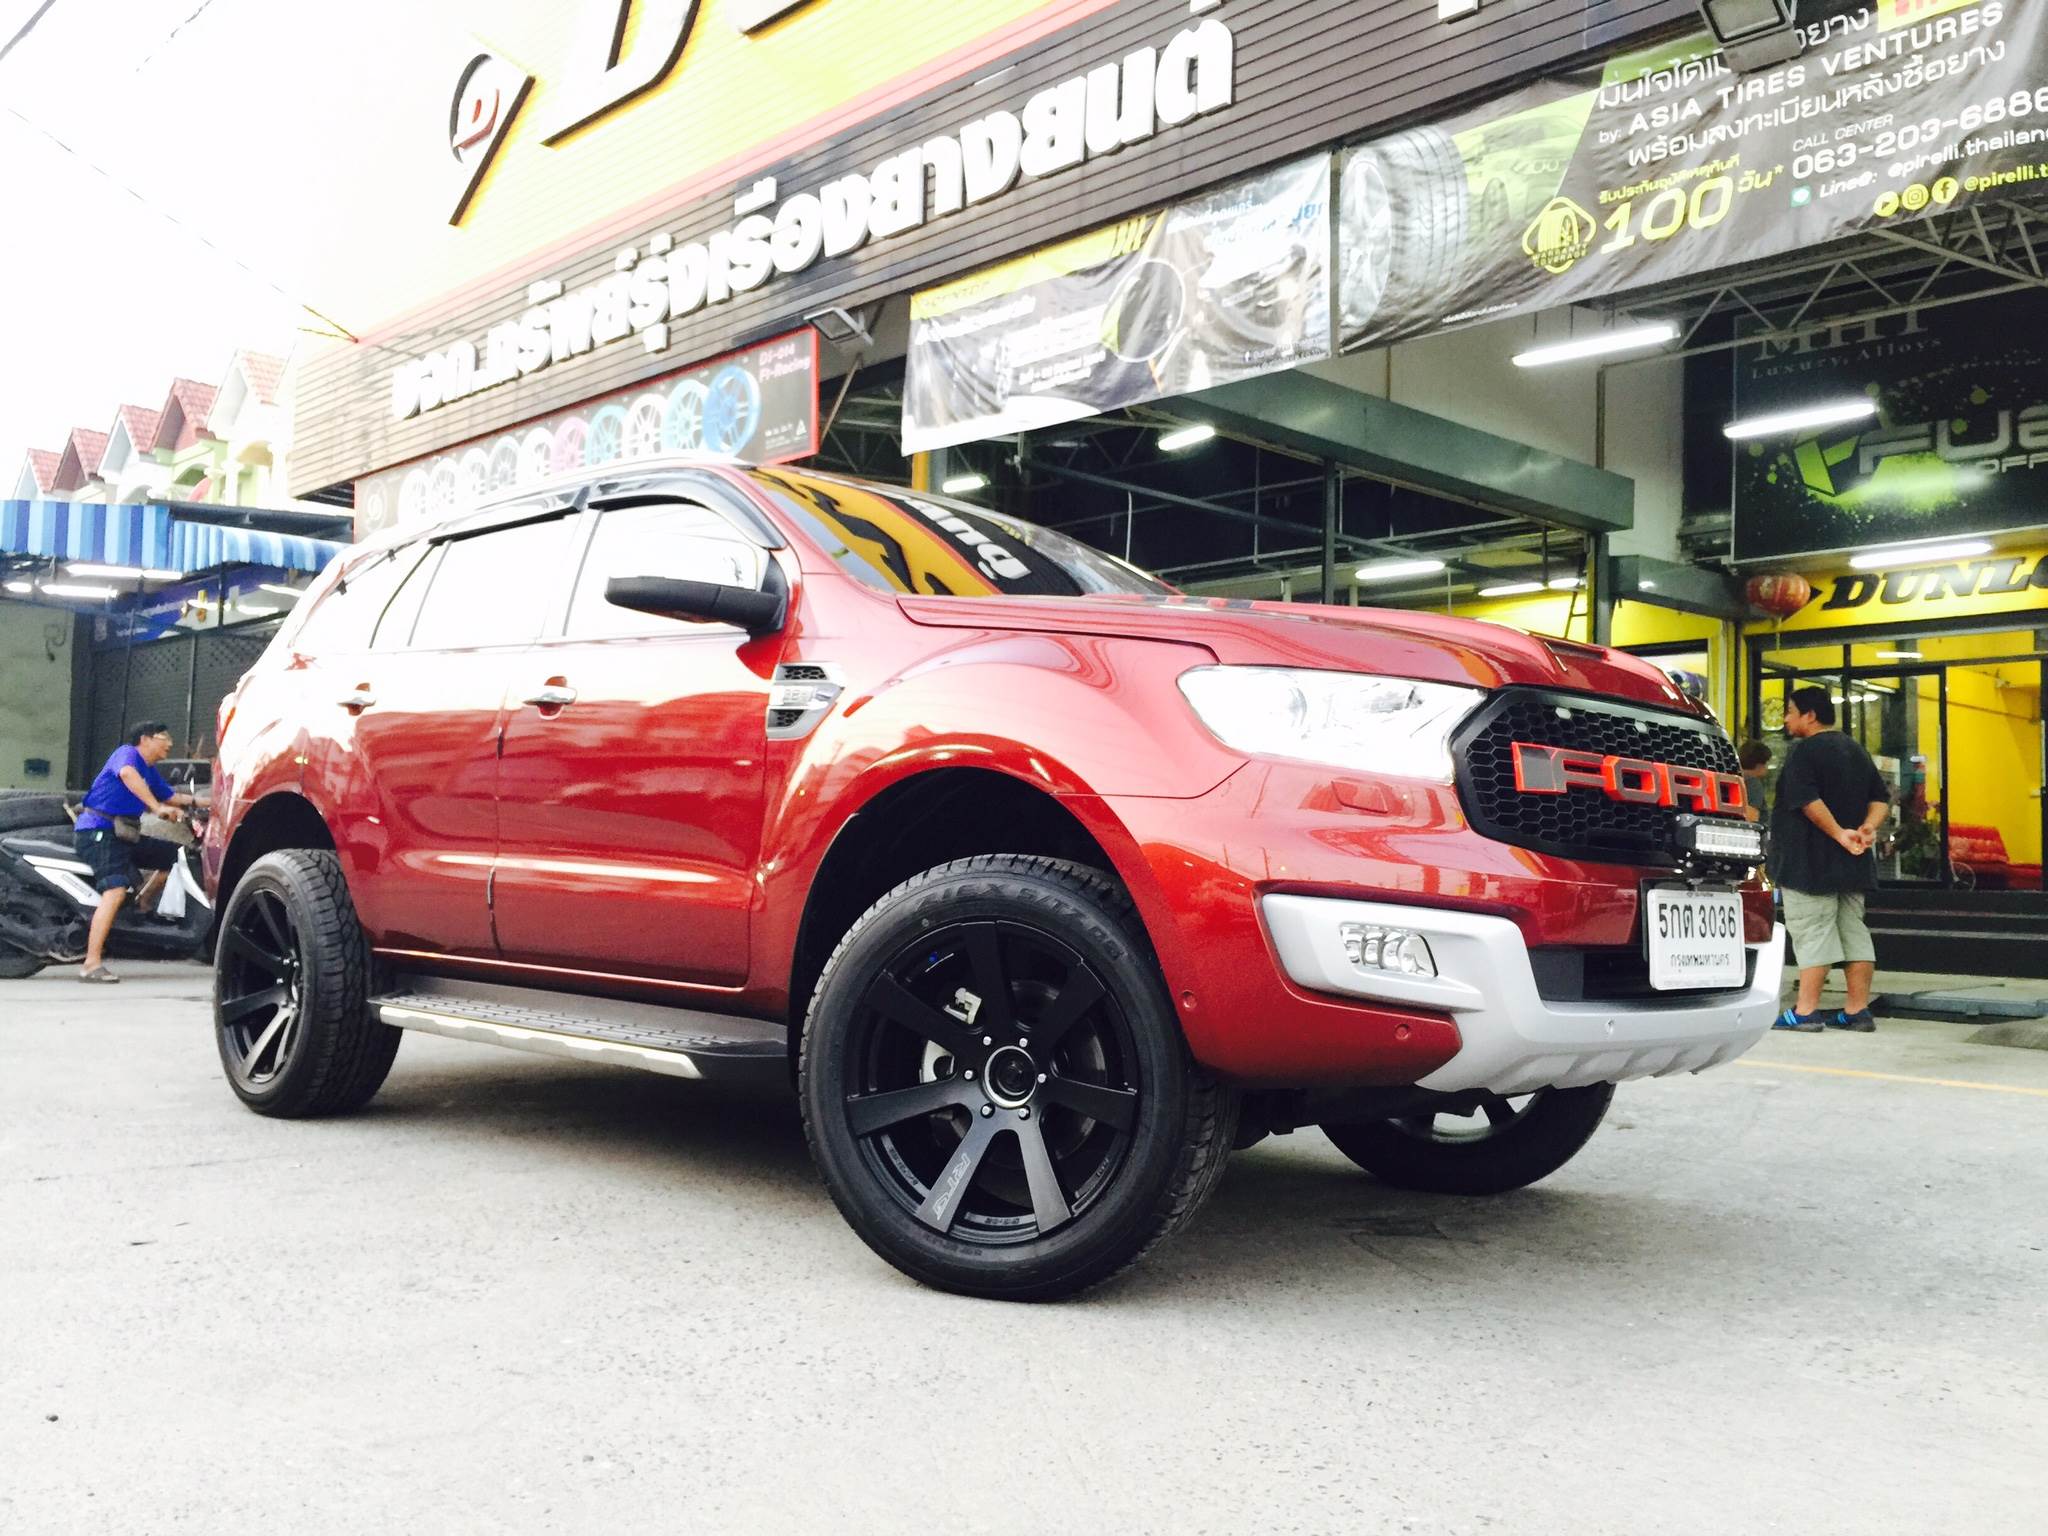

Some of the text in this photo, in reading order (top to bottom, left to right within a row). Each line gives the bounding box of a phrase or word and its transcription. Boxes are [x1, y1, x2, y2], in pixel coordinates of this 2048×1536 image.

[1599, 129, 1622, 144] by:
[1629, 98, 1702, 134] ASIA
[1717, 66, 1805, 109] TIRES
[1821, 4, 2003, 77] VENTURES
[1792, 113, 1894, 152] CALL CENTER
[1888, 127, 2048, 178] @pirelli.thailan
[1601, 176, 1734, 254] 100
[1511, 741, 1750, 821] FORD
[1698, 904, 1736, 938] 3036
